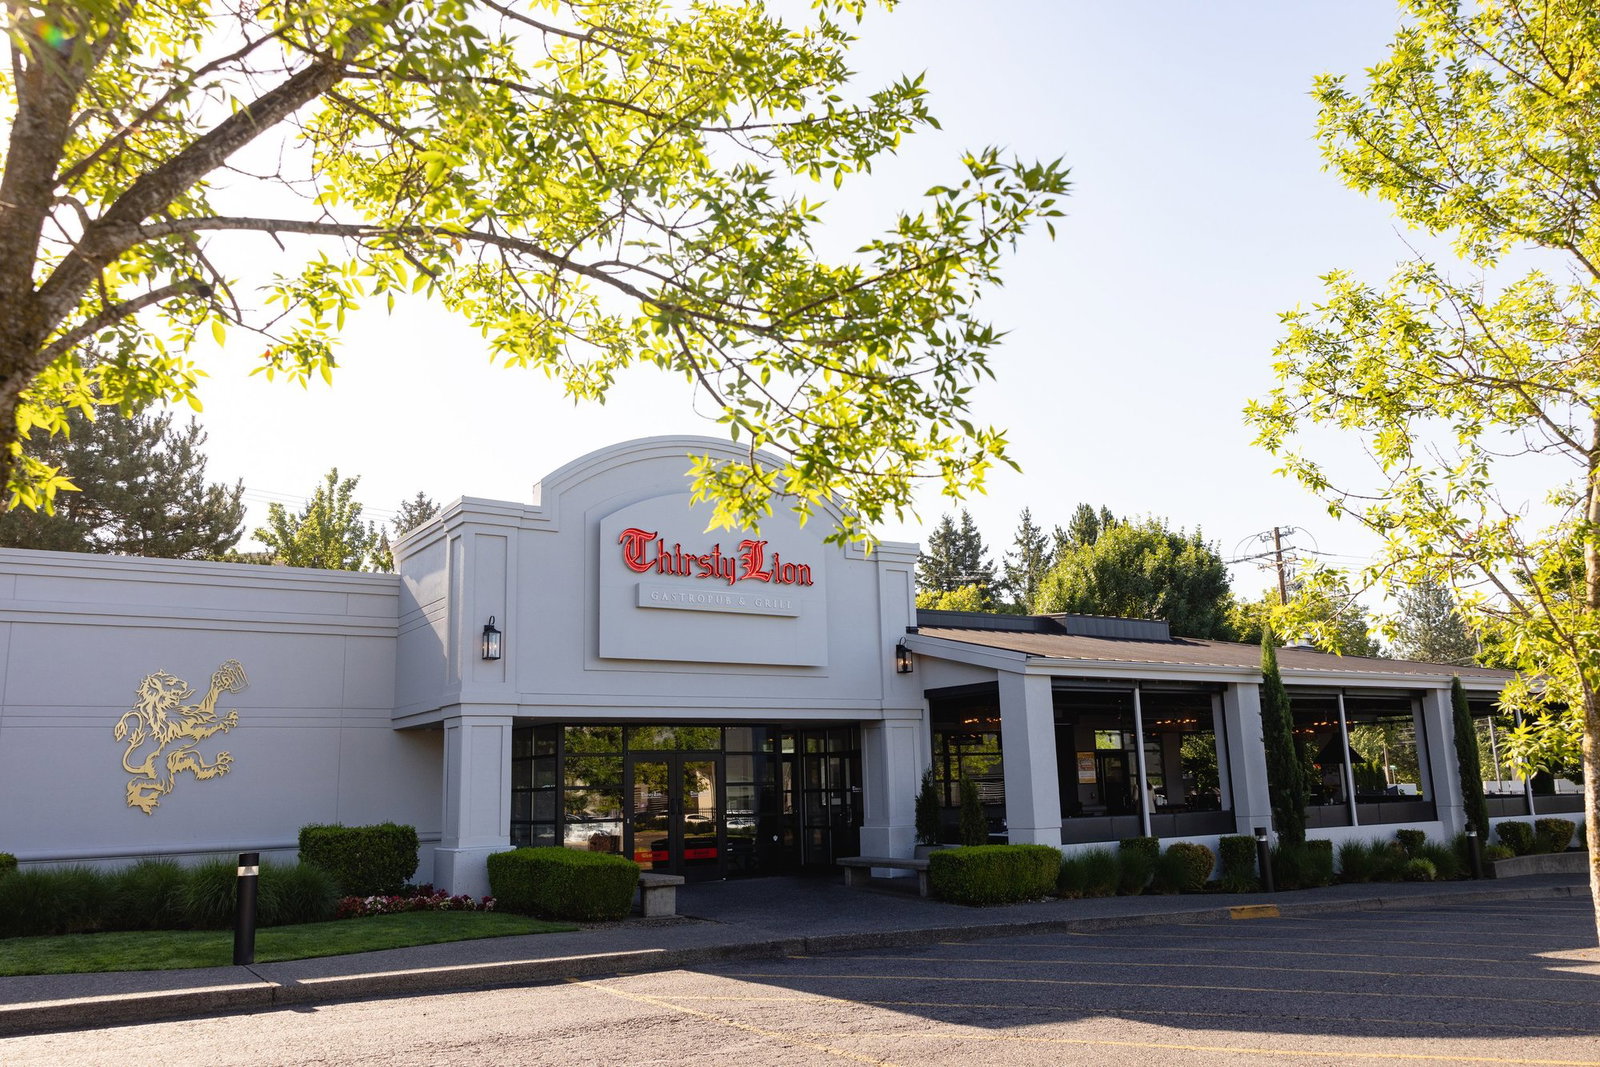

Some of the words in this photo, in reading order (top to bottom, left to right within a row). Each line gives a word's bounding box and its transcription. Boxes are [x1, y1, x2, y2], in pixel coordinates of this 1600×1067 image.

[618, 527, 736, 585] Thirsty
[738, 539, 814, 586] Lion
[651, 591, 732, 604] GASTROPUB
[738, 597, 745, 606] &
[755, 598, 793, 609] GRILL
